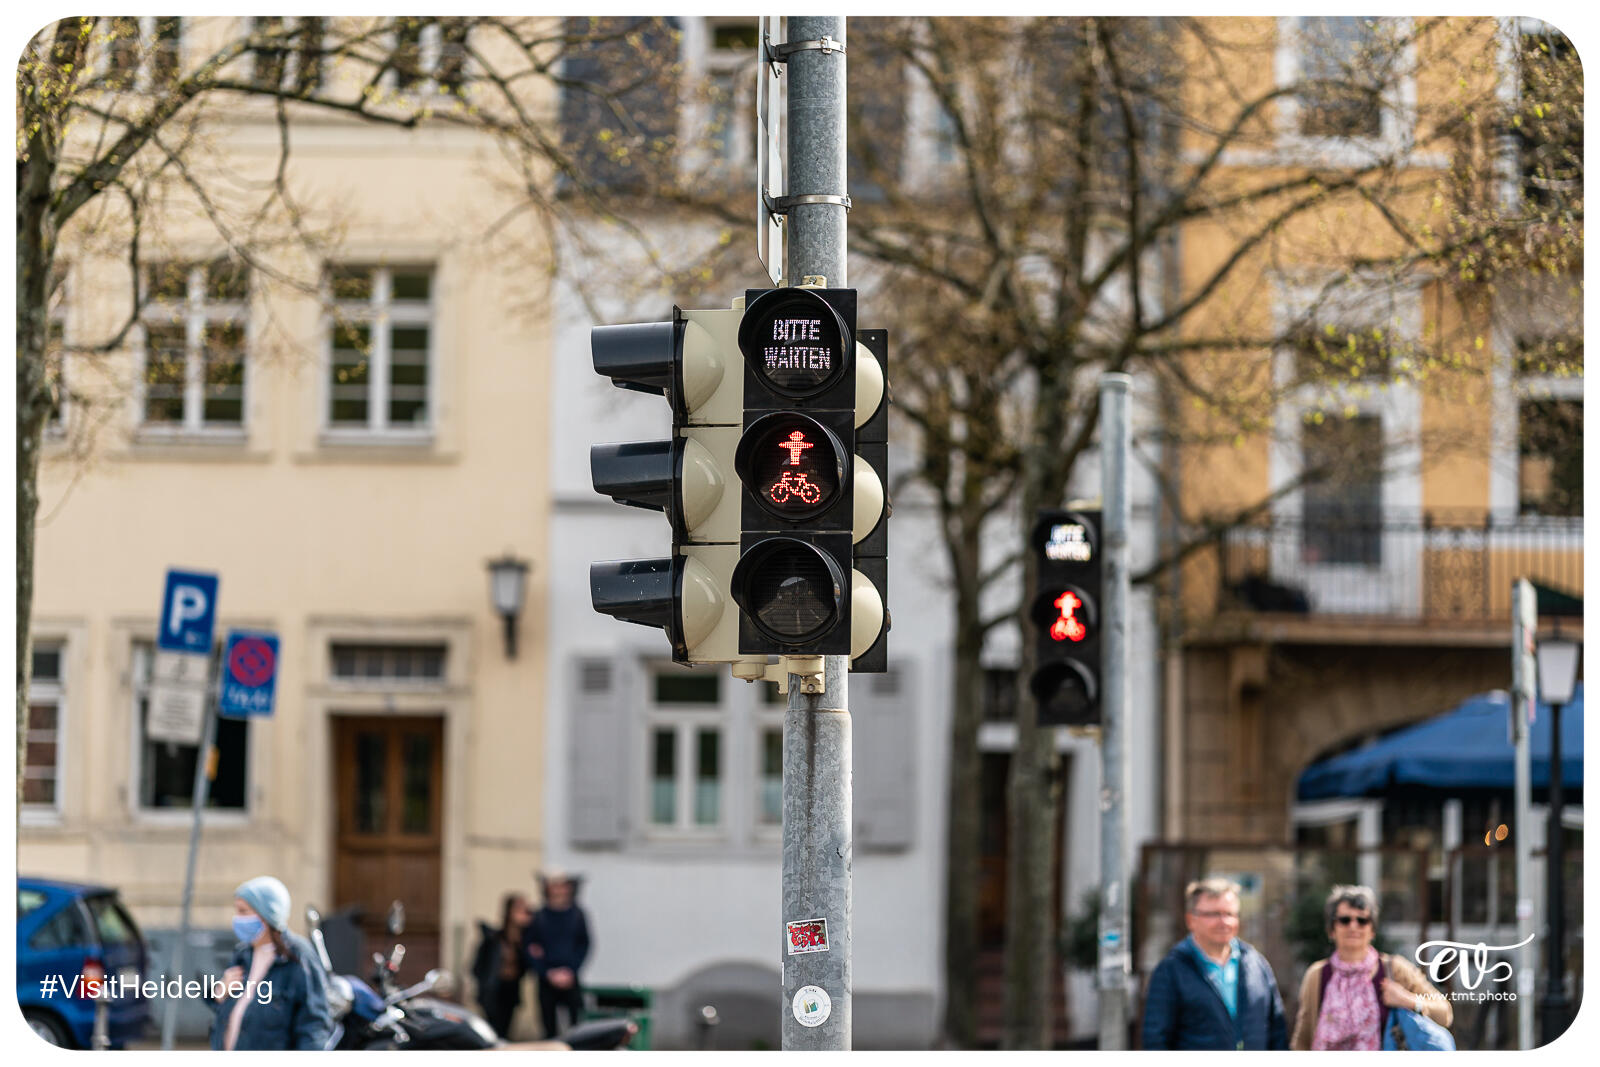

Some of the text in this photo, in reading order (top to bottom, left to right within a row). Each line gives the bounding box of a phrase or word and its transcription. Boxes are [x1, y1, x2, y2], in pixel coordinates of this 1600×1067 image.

[773, 319, 821, 341] BITTE
[764, 346, 831, 370] WARTEN
[169, 584, 208, 636] P
